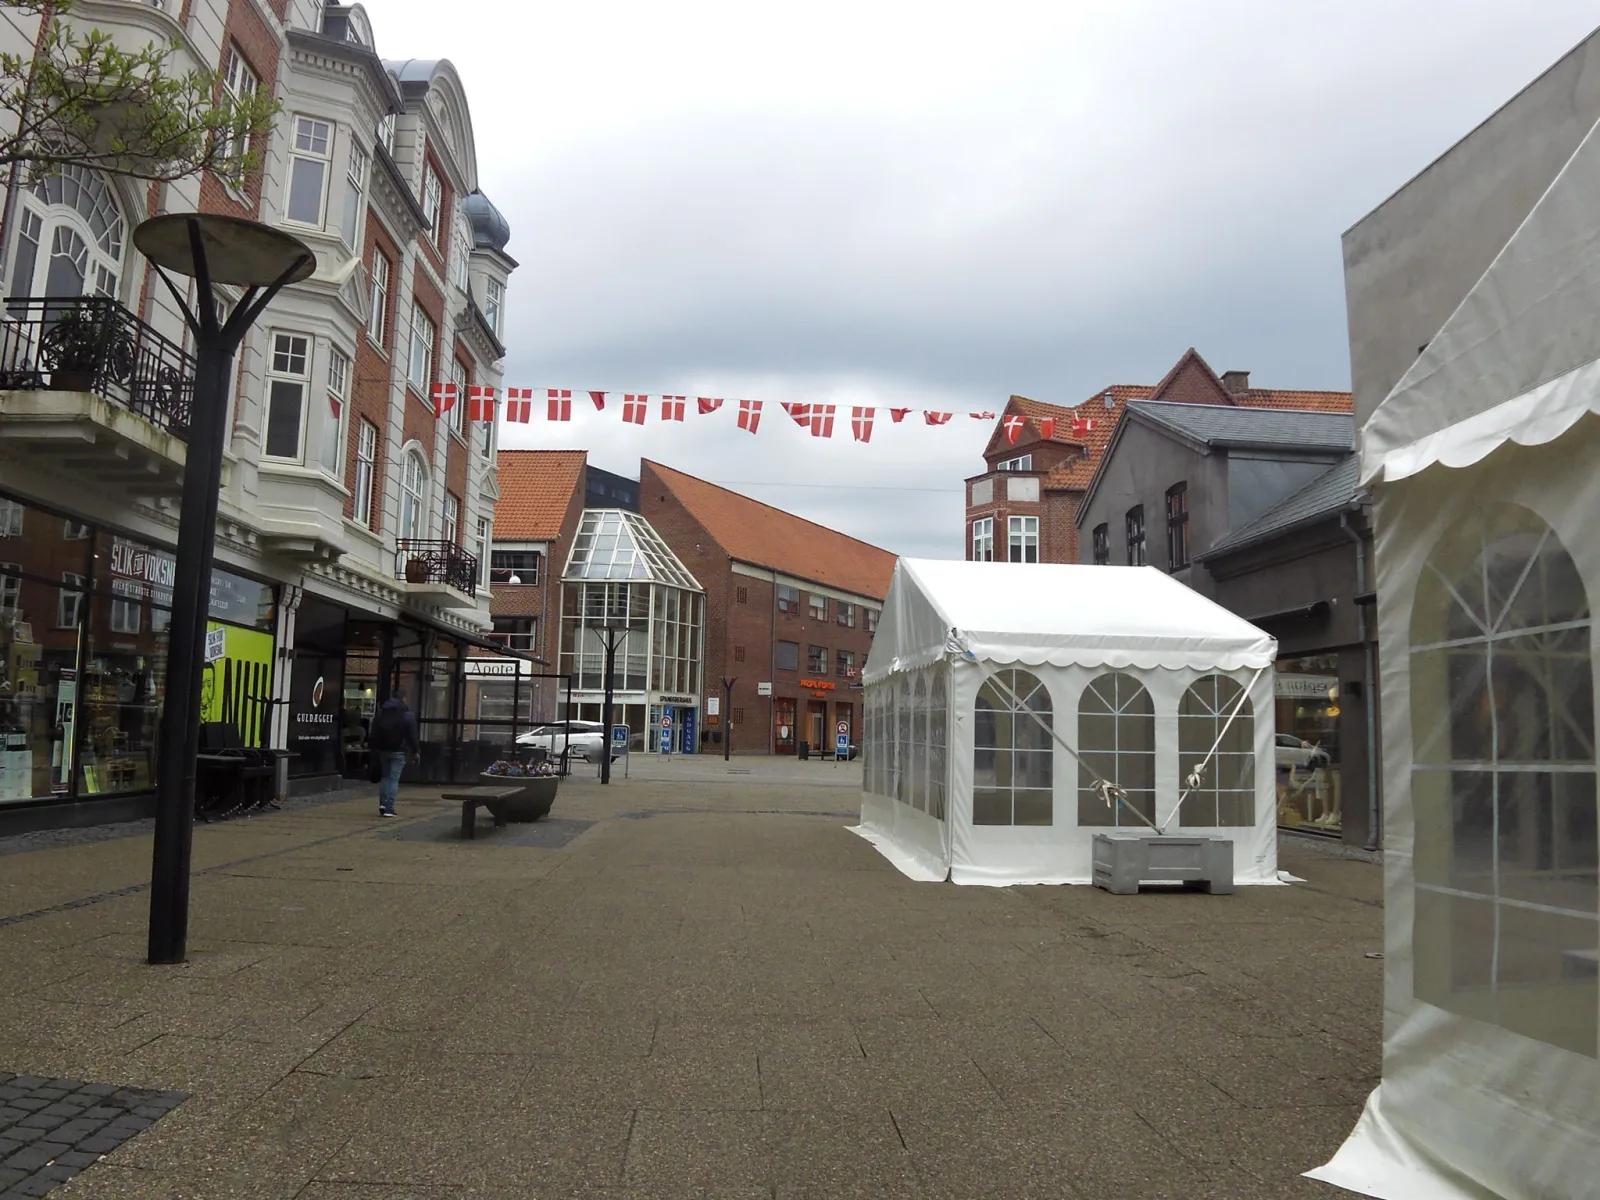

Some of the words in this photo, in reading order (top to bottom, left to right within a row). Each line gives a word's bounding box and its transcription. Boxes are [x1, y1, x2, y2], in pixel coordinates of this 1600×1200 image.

[111, 544, 134, 575] SLIK
[471, 662, 521, 677] Apote
[296, 712, 334, 723] GULDÆGGET
